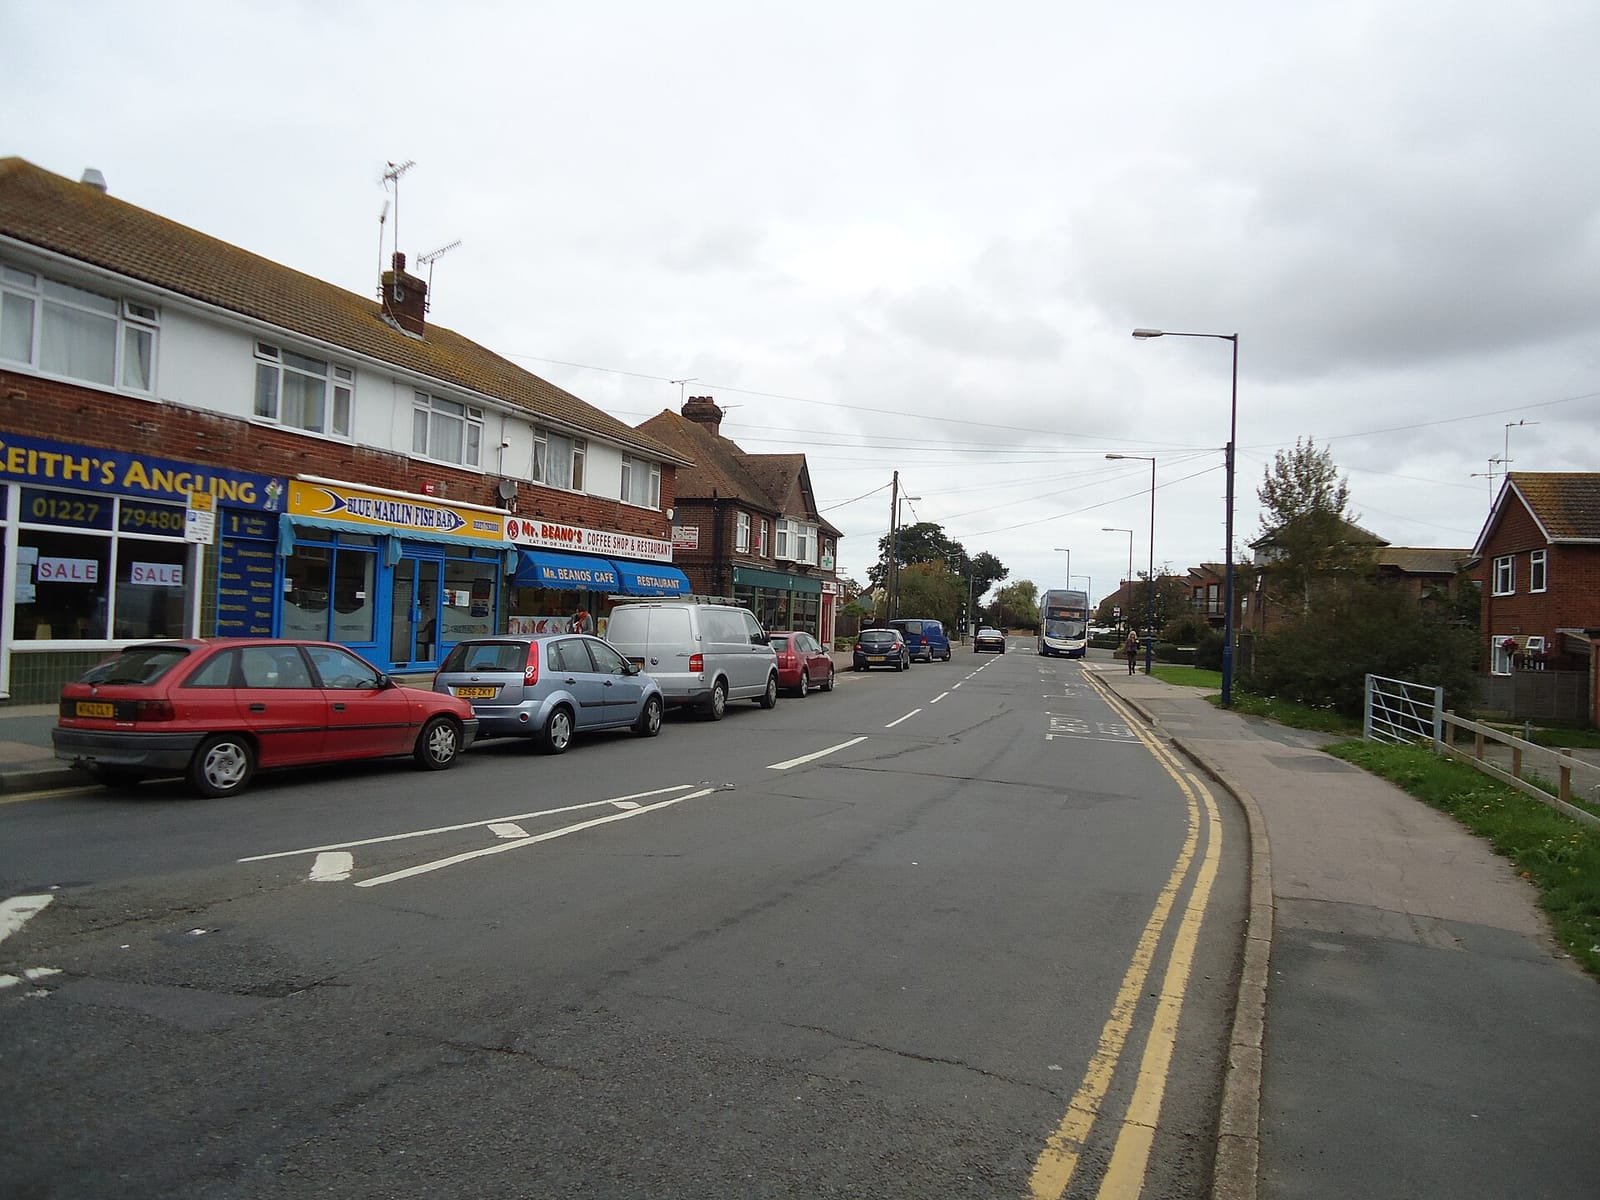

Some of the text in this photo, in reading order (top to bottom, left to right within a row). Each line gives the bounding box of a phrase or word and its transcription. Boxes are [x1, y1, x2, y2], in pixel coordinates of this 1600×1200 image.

[0, 441, 257, 504] EITH'S ANGLING
[32, 497, 99, 522] 01227
[121, 507, 187, 531] 79480
[347, 498, 371, 517] BLUE
[373, 500, 412, 524] MARLIN
[415, 506, 434, 526] FISH
[436, 508, 453, 528] BAR
[522, 521, 538, 537] Mr.
[541, 524, 583, 544] BEANO'S
[587, 532, 611, 548] COFFEE
[613, 536, 628, 550] SHOP
[631, 540, 635, 551] &
[637, 540, 671, 556] RESTAURANT
[41, 562, 97, 580] SALE
[134, 567, 181, 583] SALE
[594, 572, 615, 583] CAFE
[637, 576, 680, 589] RESTAURANT
